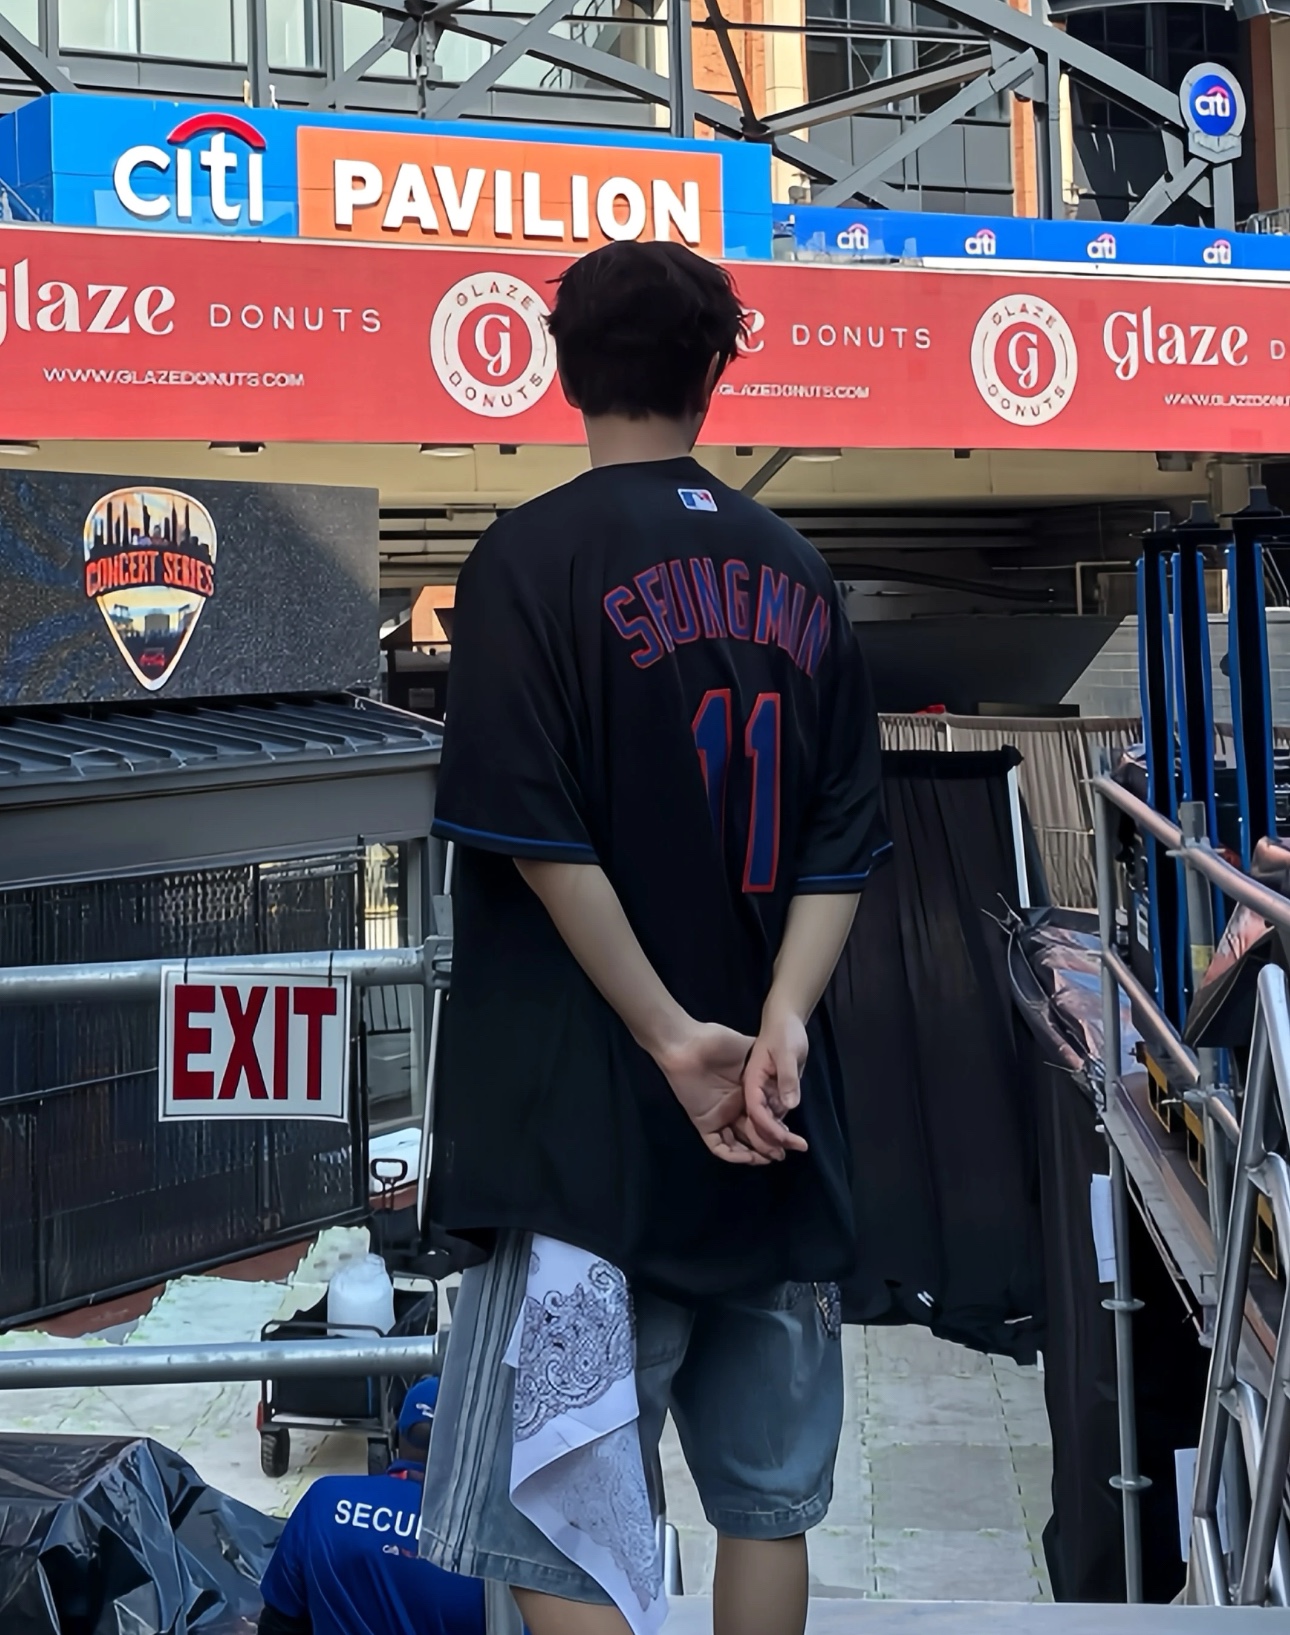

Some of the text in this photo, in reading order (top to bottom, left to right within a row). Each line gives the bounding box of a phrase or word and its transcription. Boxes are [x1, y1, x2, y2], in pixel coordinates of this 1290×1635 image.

[1195, 91, 1230, 118] citi
[112, 130, 701, 247] citi PAVILION
[836, 227, 869, 250] citi
[964, 232, 996, 255] citi
[1086, 237, 1117, 259] citi
[1202, 244, 1232, 265] citi
[0, 257, 382, 346] laze DONUTS
[791, 323, 932, 349] DONUTS
[448, 371, 543, 408] DONUTS
[987, 383, 1066, 417] DONUTS
[85, 550, 215, 598] CONCERT SERIES
[603, 556, 832, 679] SEUNGMIN
[691, 687, 782, 893] 11
[172, 984, 337, 1101] EXIT
[334, 1499, 421, 1541] SECU
